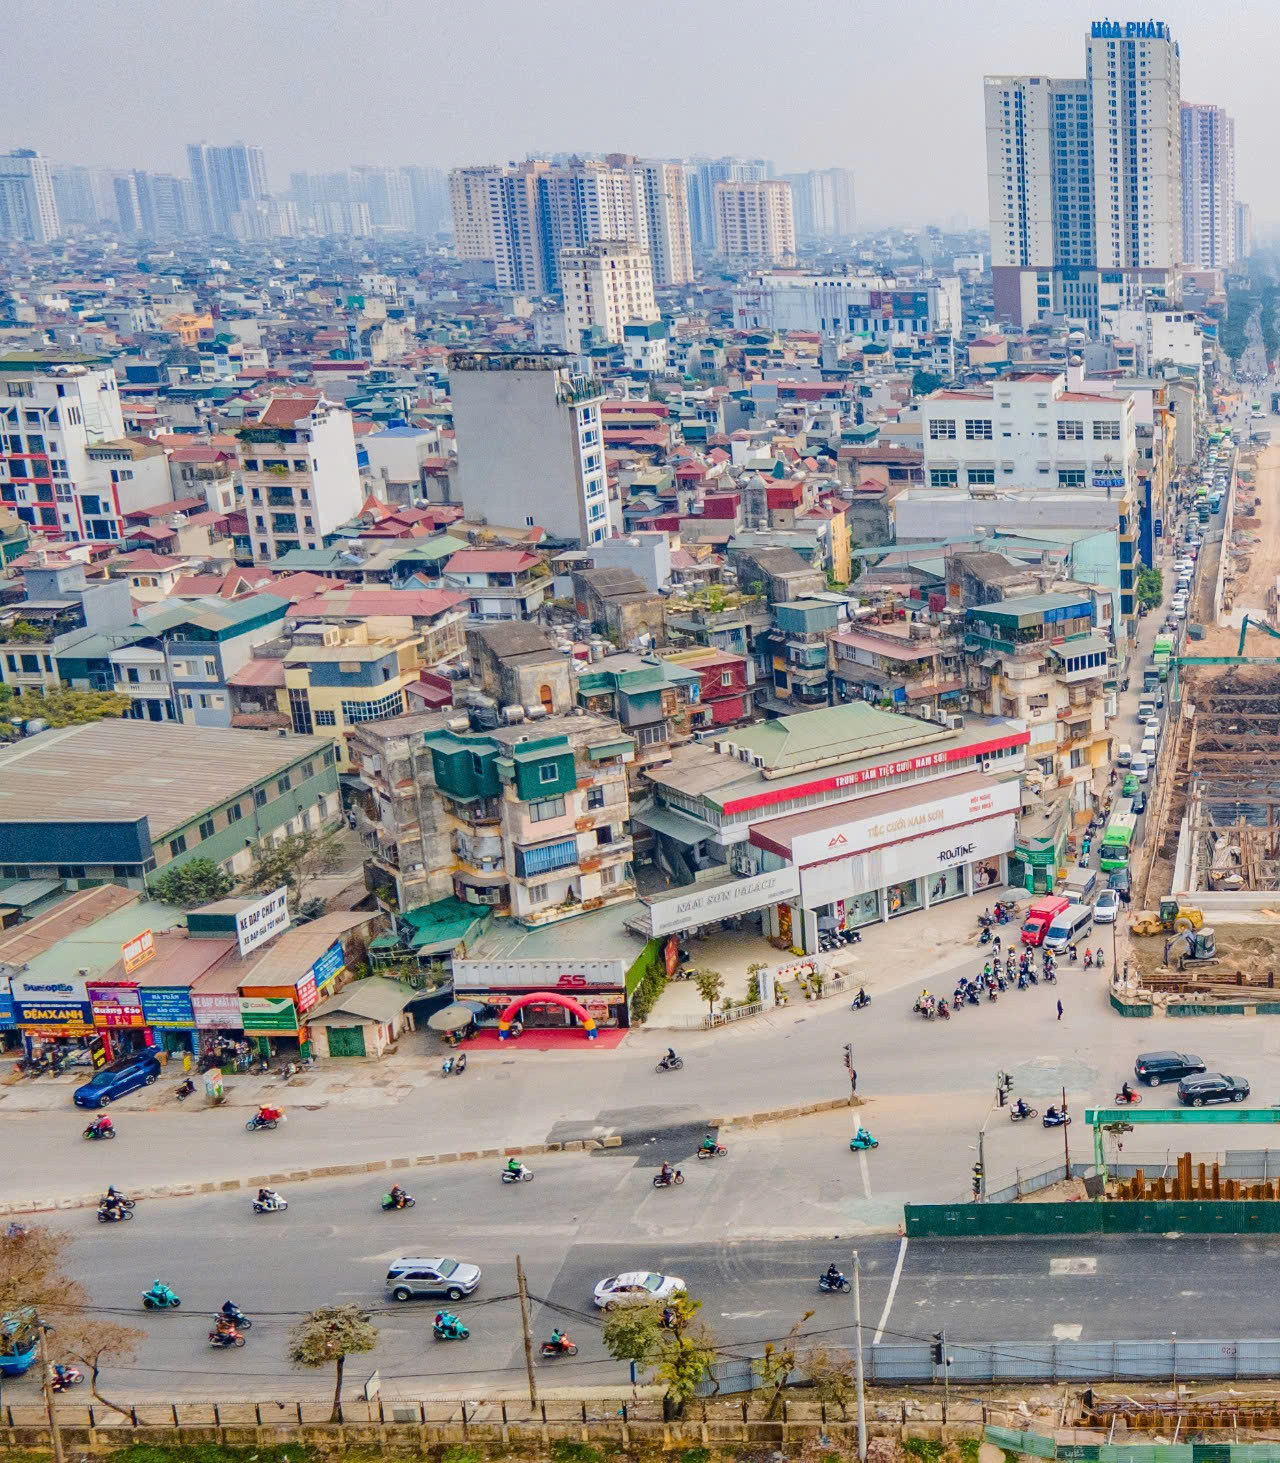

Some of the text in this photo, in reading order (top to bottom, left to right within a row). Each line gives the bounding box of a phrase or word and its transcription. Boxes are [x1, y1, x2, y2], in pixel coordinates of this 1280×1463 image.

[1092, 18, 1164, 38] HÒA PHÁT
[915, 756, 932, 768] NAM
[240, 916, 248, 931] XE
